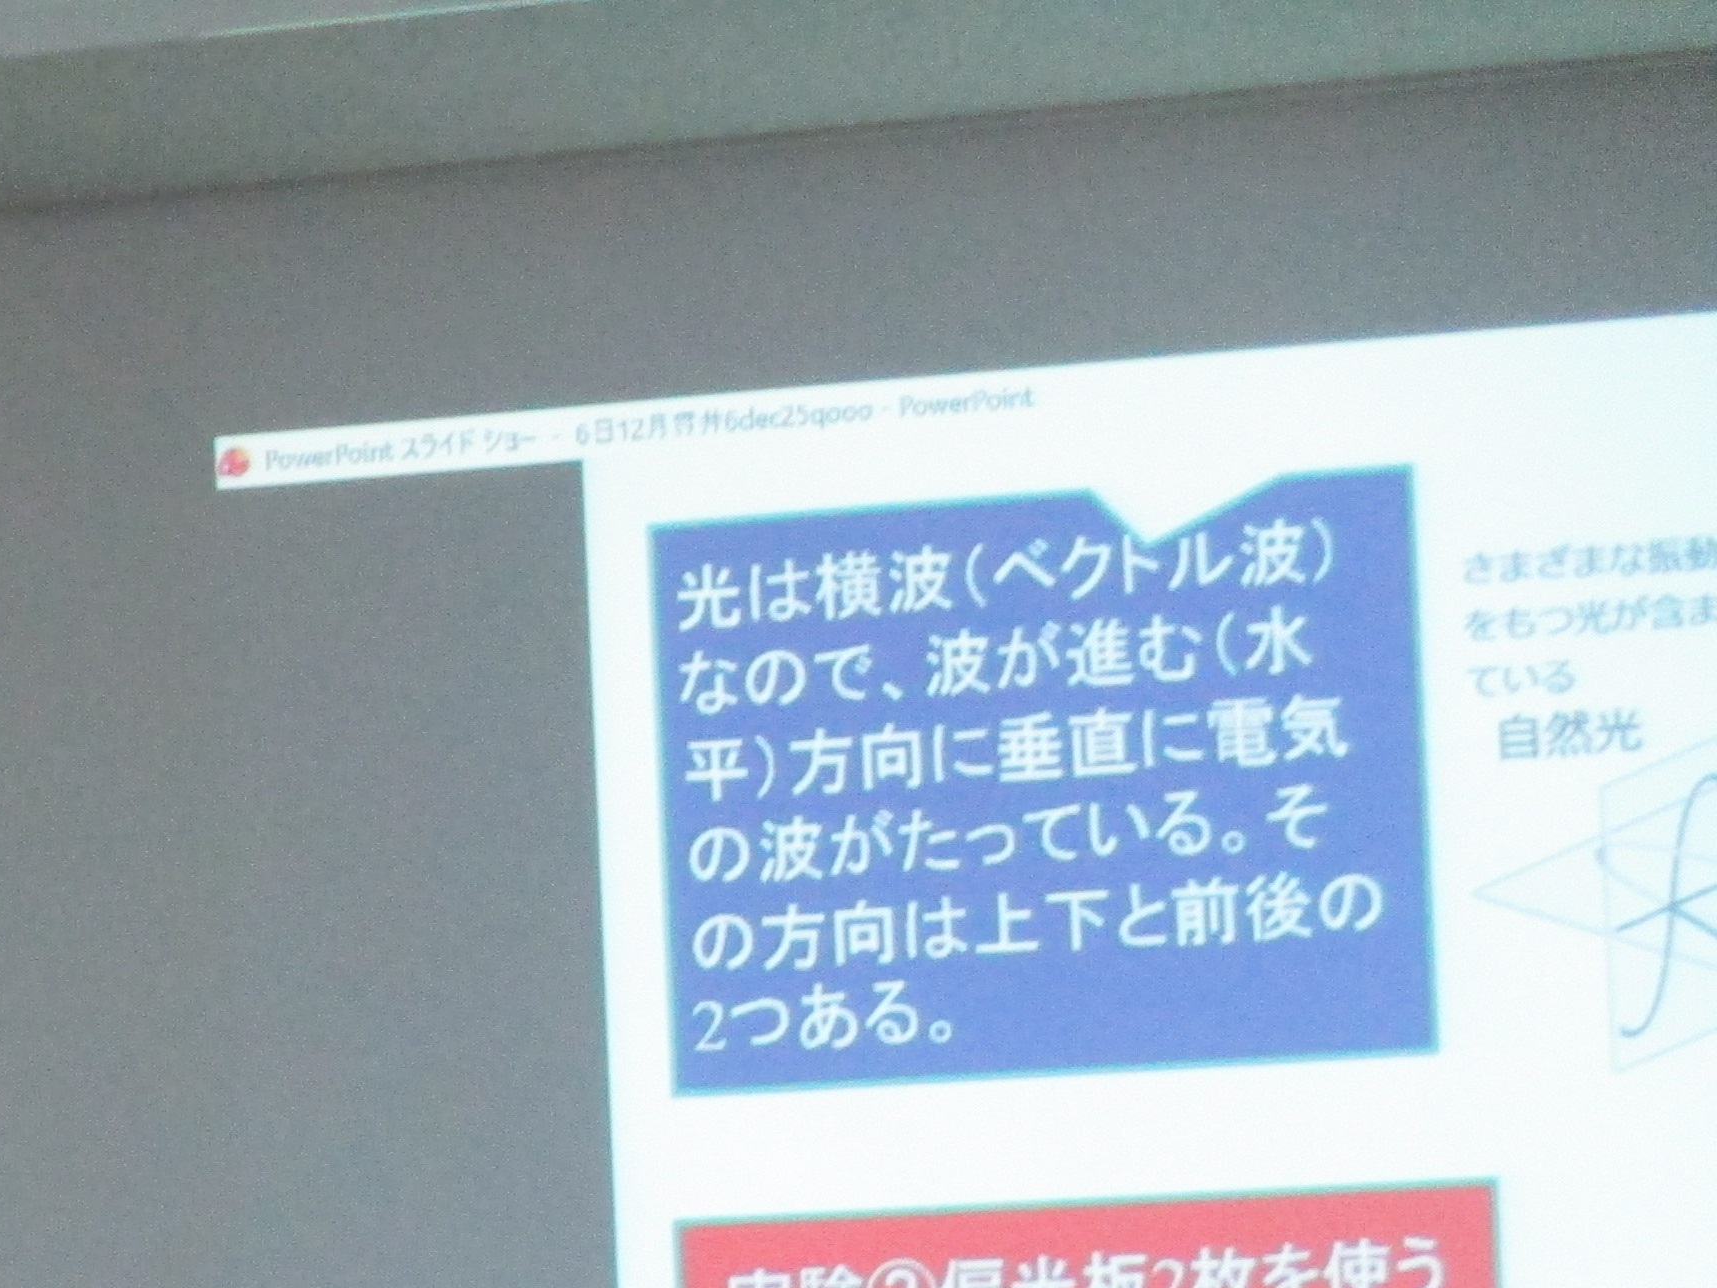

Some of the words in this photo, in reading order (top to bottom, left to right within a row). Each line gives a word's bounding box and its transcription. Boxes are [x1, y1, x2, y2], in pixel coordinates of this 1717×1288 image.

[264, 440, 395, 472] PowerPoint
[401, 429, 475, 461] スライド
[899, 387, 1035, 418] PowerPoint
[1462, 535, 1717, 585] さまざまな振動
[1464, 591, 1717, 642] をもつ光が含ま
[1467, 658, 1577, 698] ている
[1497, 707, 1644, 761] 自然光
[687, 783, 1329, 886] の波がたっている。そ
[690, 872, 1383, 974] の方向は上下と前後の
[692, 979, 956, 1055] 2つある。
